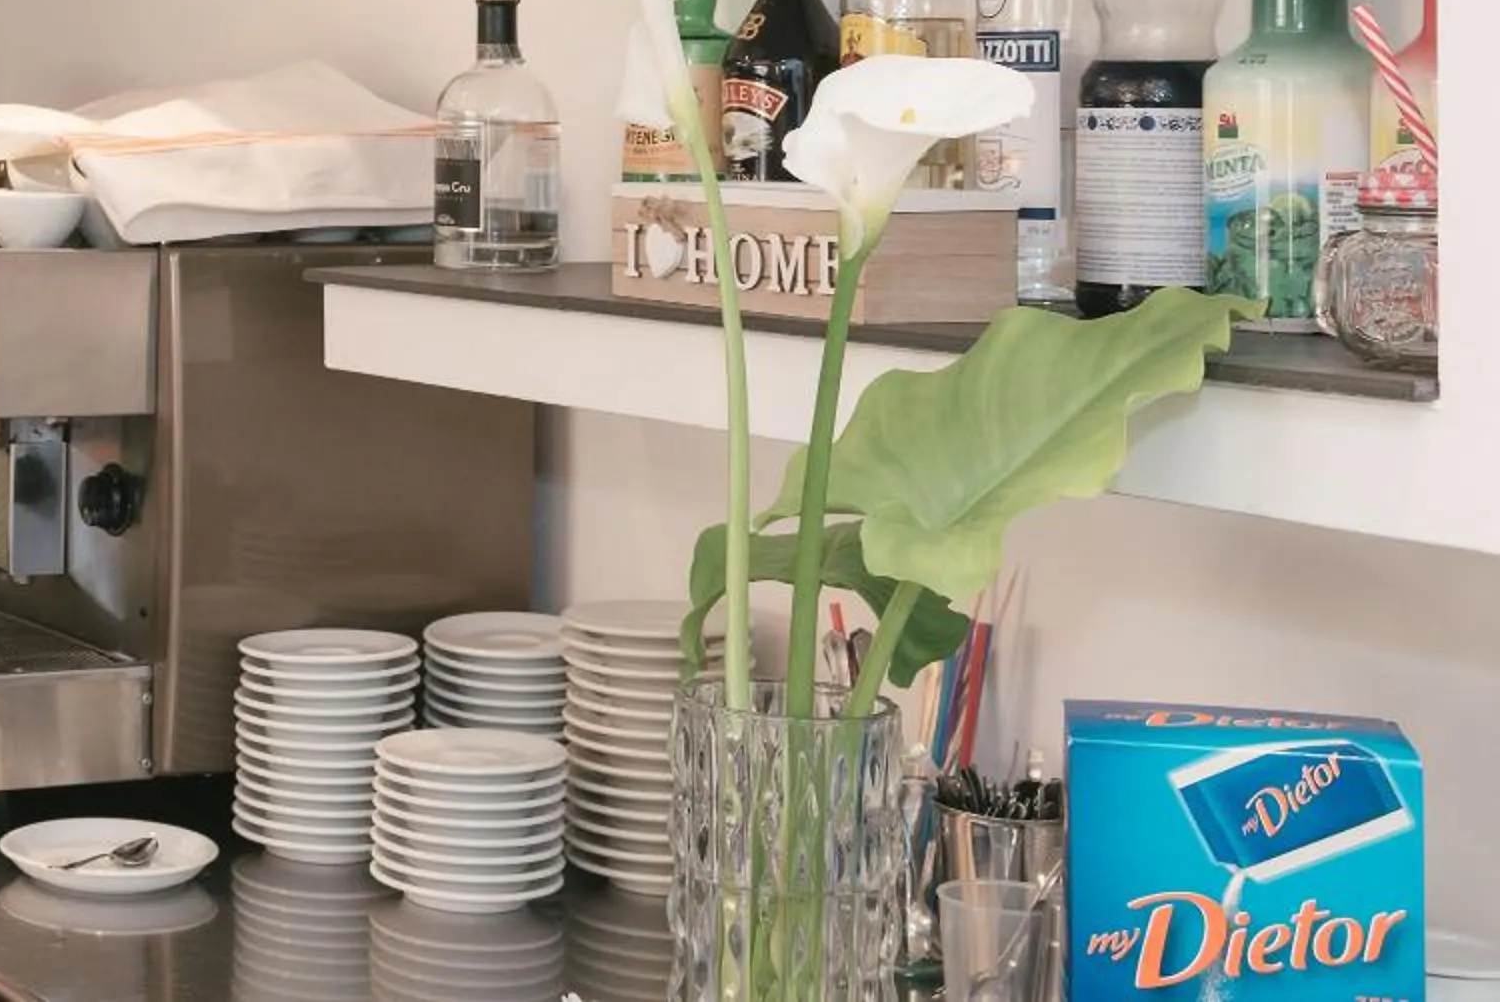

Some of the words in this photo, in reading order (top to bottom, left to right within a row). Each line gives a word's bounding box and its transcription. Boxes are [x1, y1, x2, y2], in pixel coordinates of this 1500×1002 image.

[685, 226, 839, 296] HOME
[1245, 752, 1343, 838] Dietor
[1087, 927, 1141, 961] my
[1126, 891, 1408, 990] Dietor
